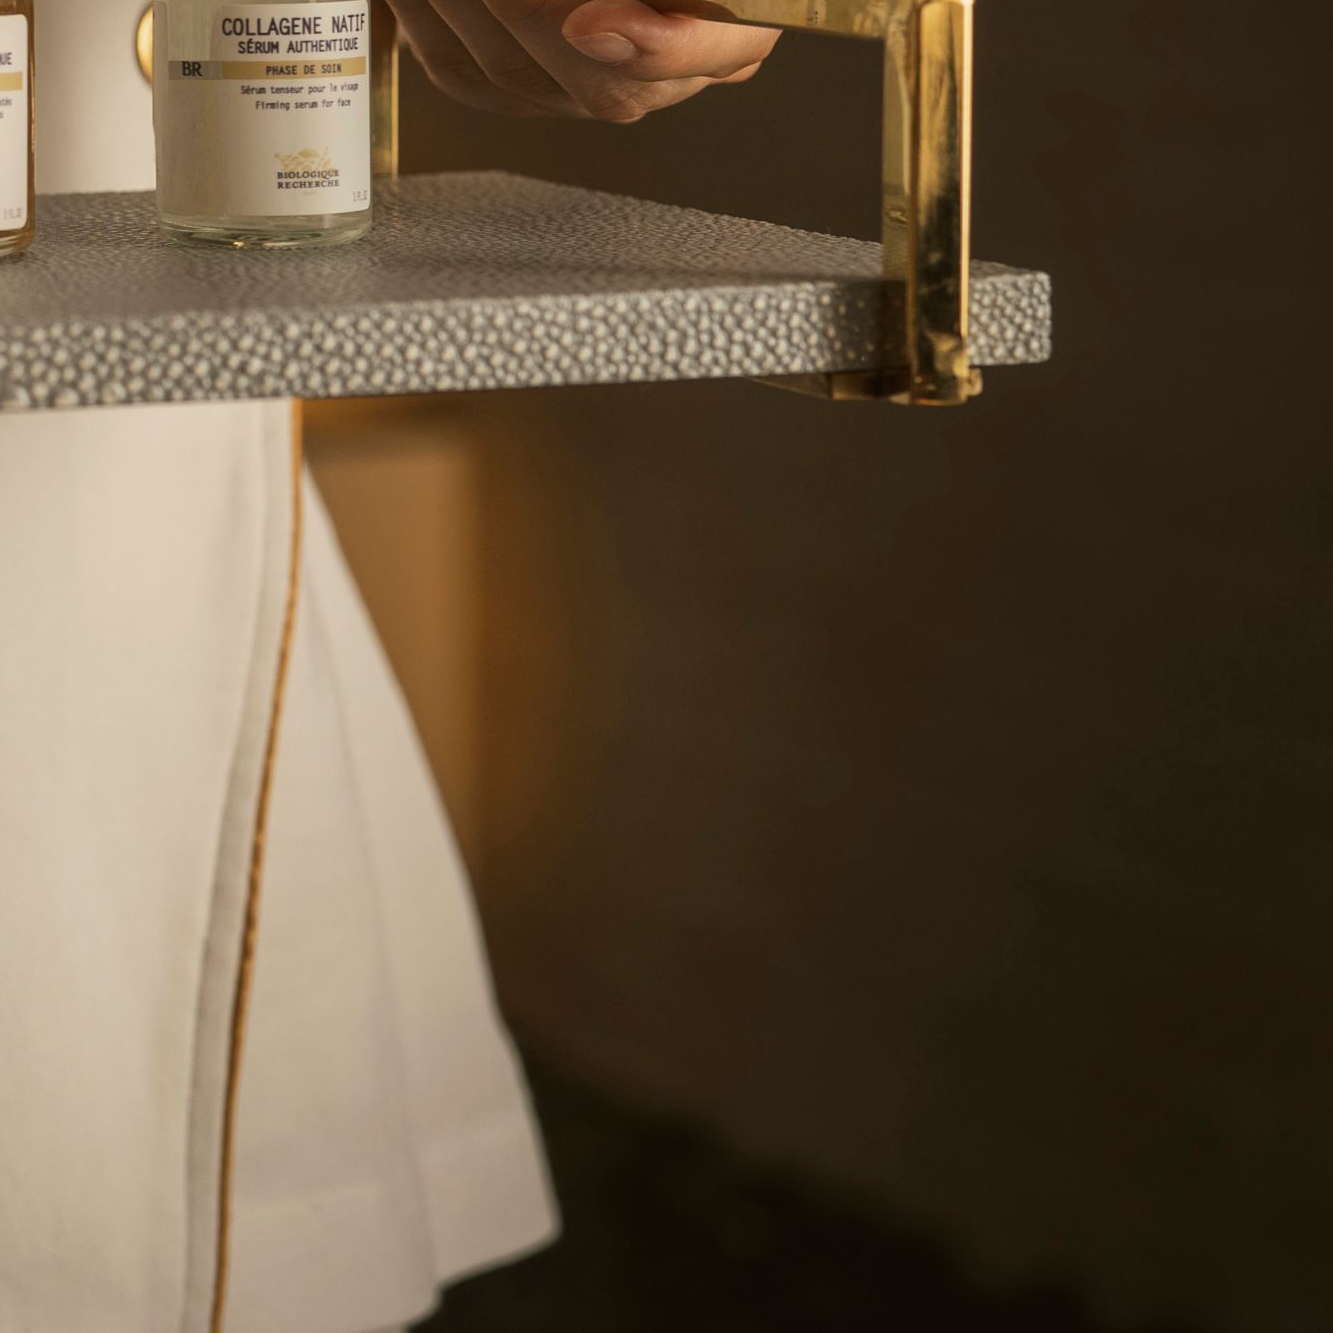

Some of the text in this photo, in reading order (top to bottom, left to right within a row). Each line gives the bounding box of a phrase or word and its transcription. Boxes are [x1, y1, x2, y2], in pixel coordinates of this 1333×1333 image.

[222, 13, 364, 36] COLLAGENE NATIF
[238, 38, 358, 54] SÉRUM AUTHENTIQUE
[182, 61, 203, 77] BR
[266, 64, 341, 75] PHASE DE SOIN
[241, 83, 359, 95] Sérum tenseur pour le visage
[256, 98, 351, 110] Firming serum for face
[277, 170, 339, 179] BIOLOGIQUE
[277, 180, 340, 189] RECHERCHE
